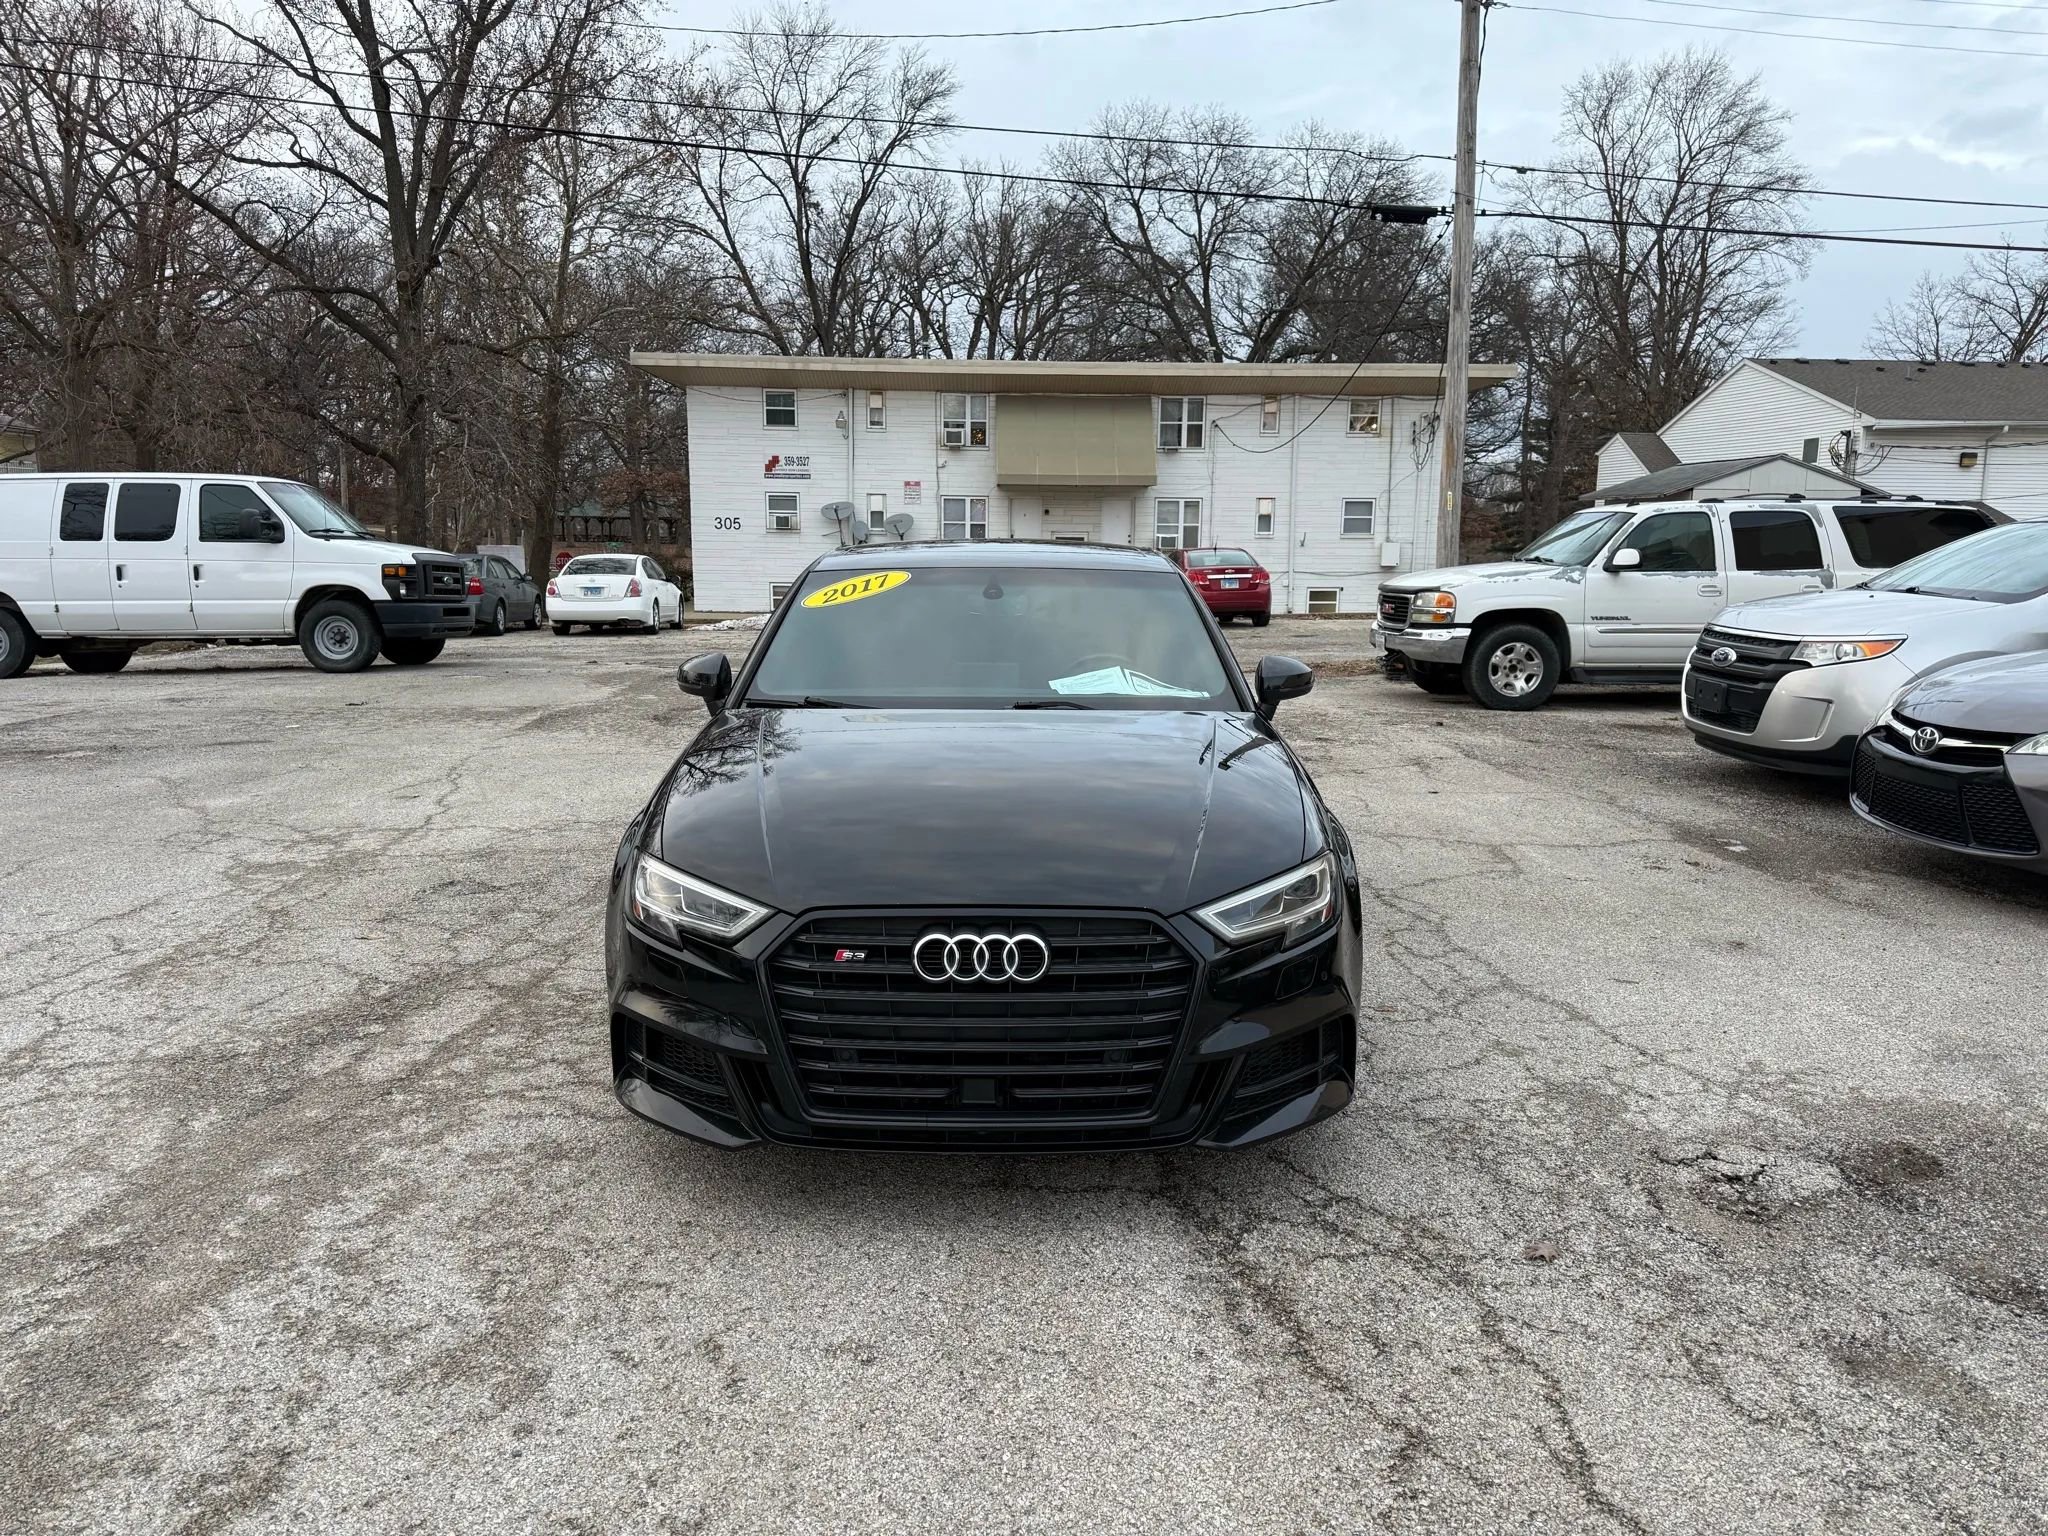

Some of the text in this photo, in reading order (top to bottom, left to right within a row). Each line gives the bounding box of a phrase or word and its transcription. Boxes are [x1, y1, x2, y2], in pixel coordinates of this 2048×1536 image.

[783, 456, 810, 466] 359-3527
[714, 516, 741, 530] 305
[822, 574, 889, 604] 2017
